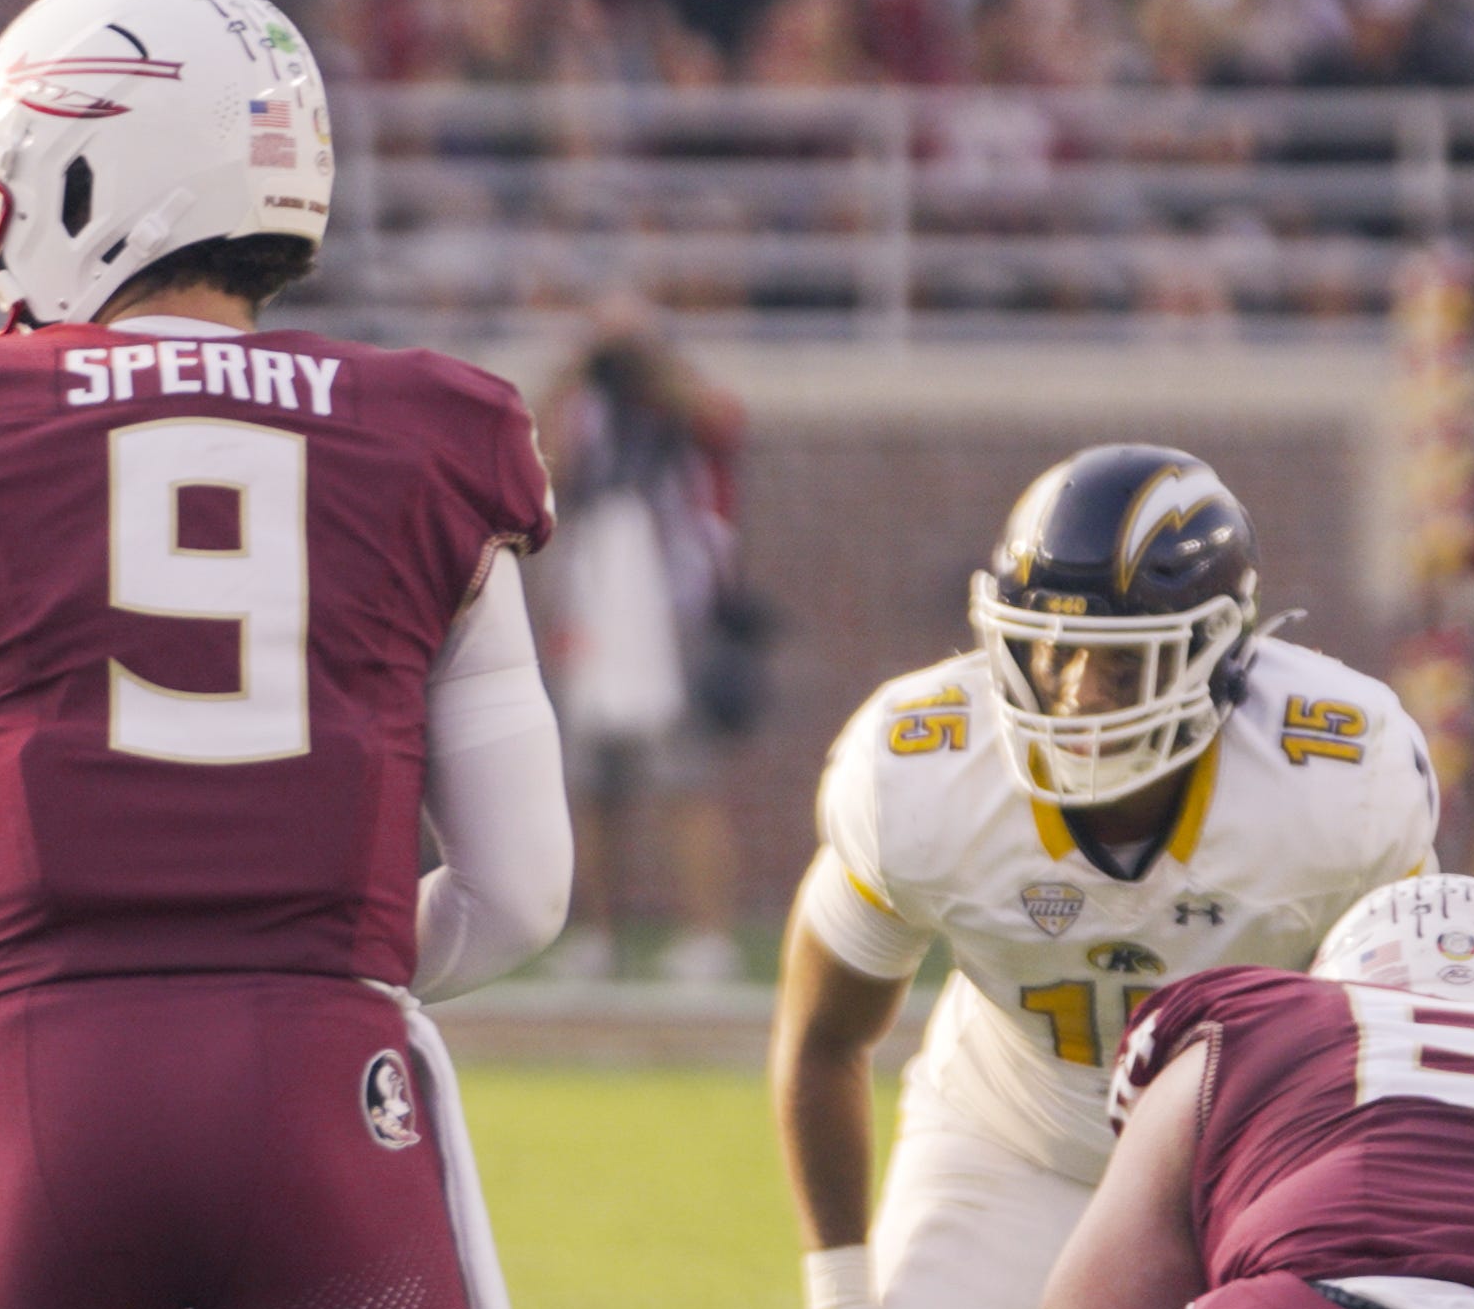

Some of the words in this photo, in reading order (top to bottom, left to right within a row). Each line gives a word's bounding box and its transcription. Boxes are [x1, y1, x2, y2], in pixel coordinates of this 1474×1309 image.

[64, 340, 341, 416] SPERRY
[108, 416, 311, 765] 9
[887, 683, 972, 758] 15
[1279, 694, 1369, 766] 15
